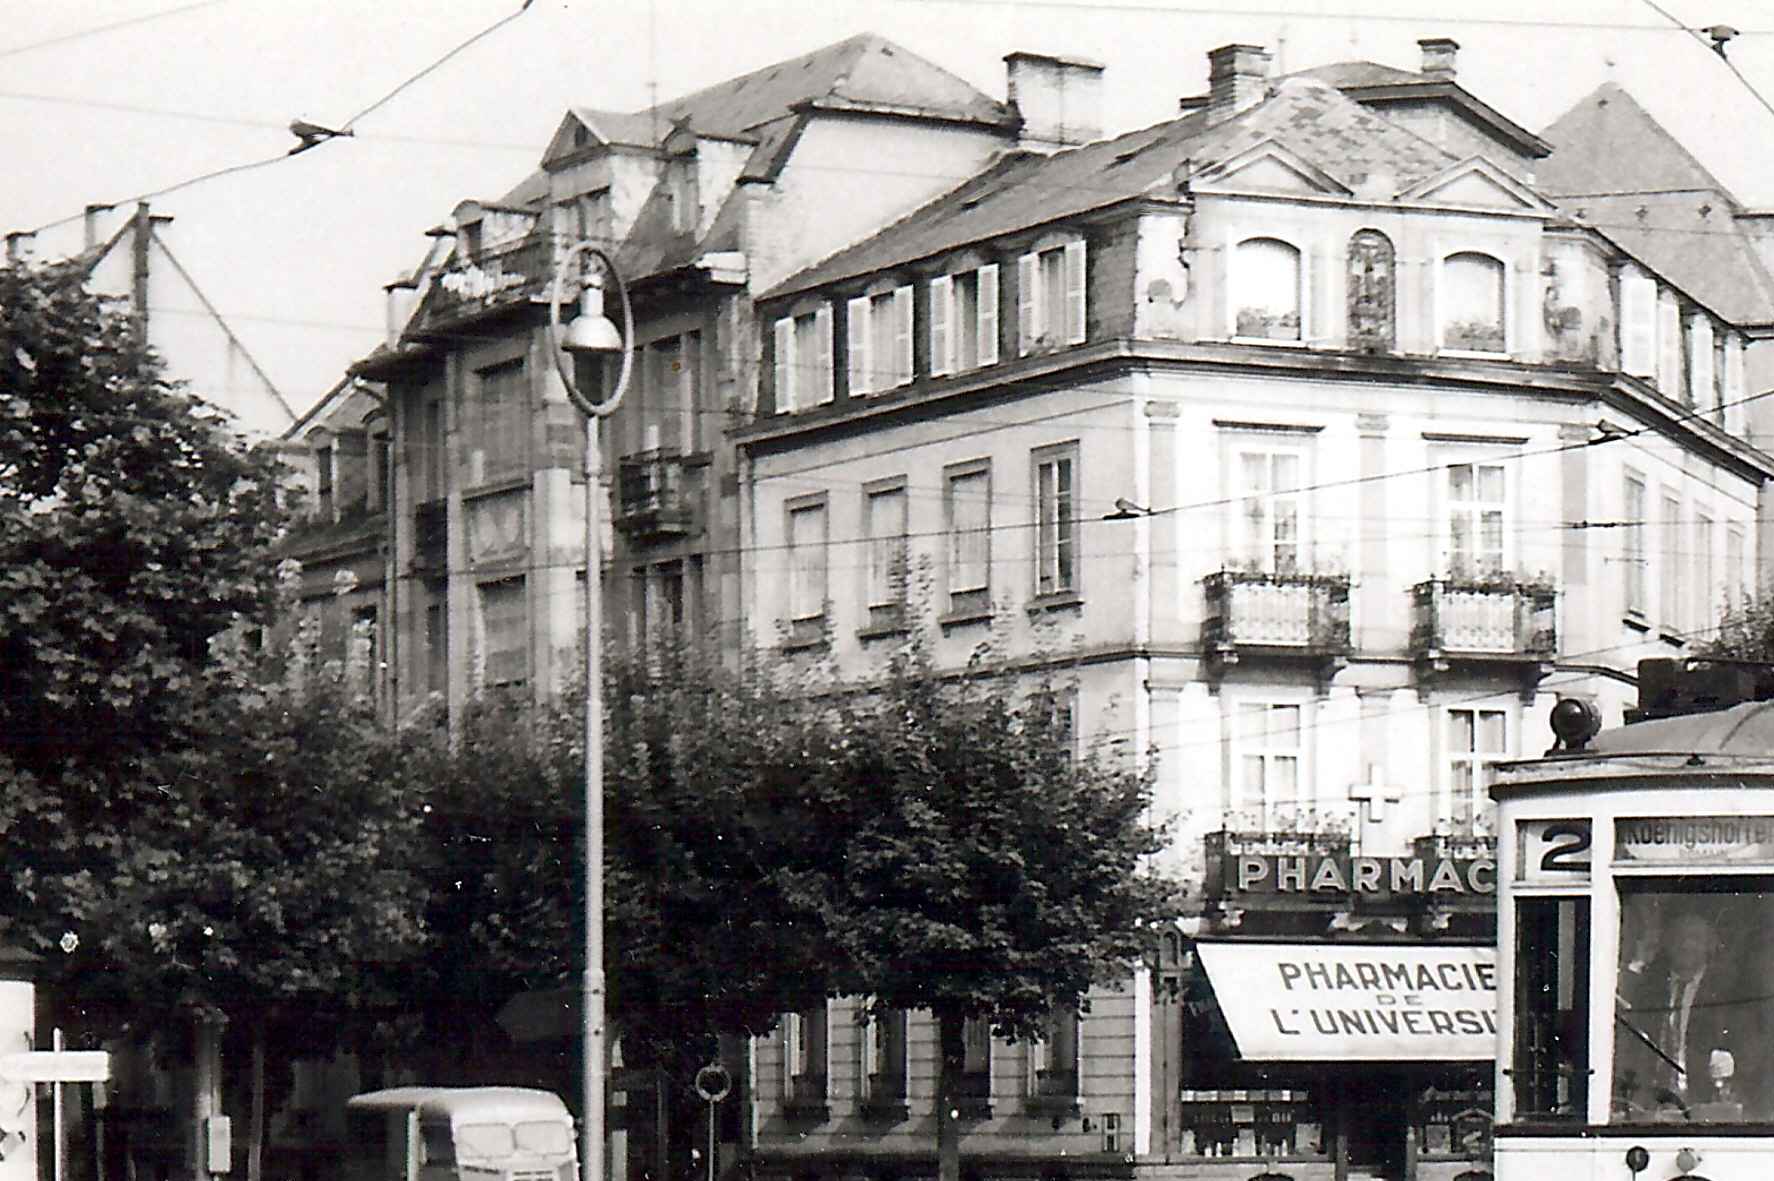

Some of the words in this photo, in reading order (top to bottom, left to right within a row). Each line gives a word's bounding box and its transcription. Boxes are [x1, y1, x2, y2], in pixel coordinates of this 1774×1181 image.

[1540, 824, 1591, 872] 2
[1277, 961, 1498, 991] PHARMACIE
[1376, 994, 1423, 1006] DE
